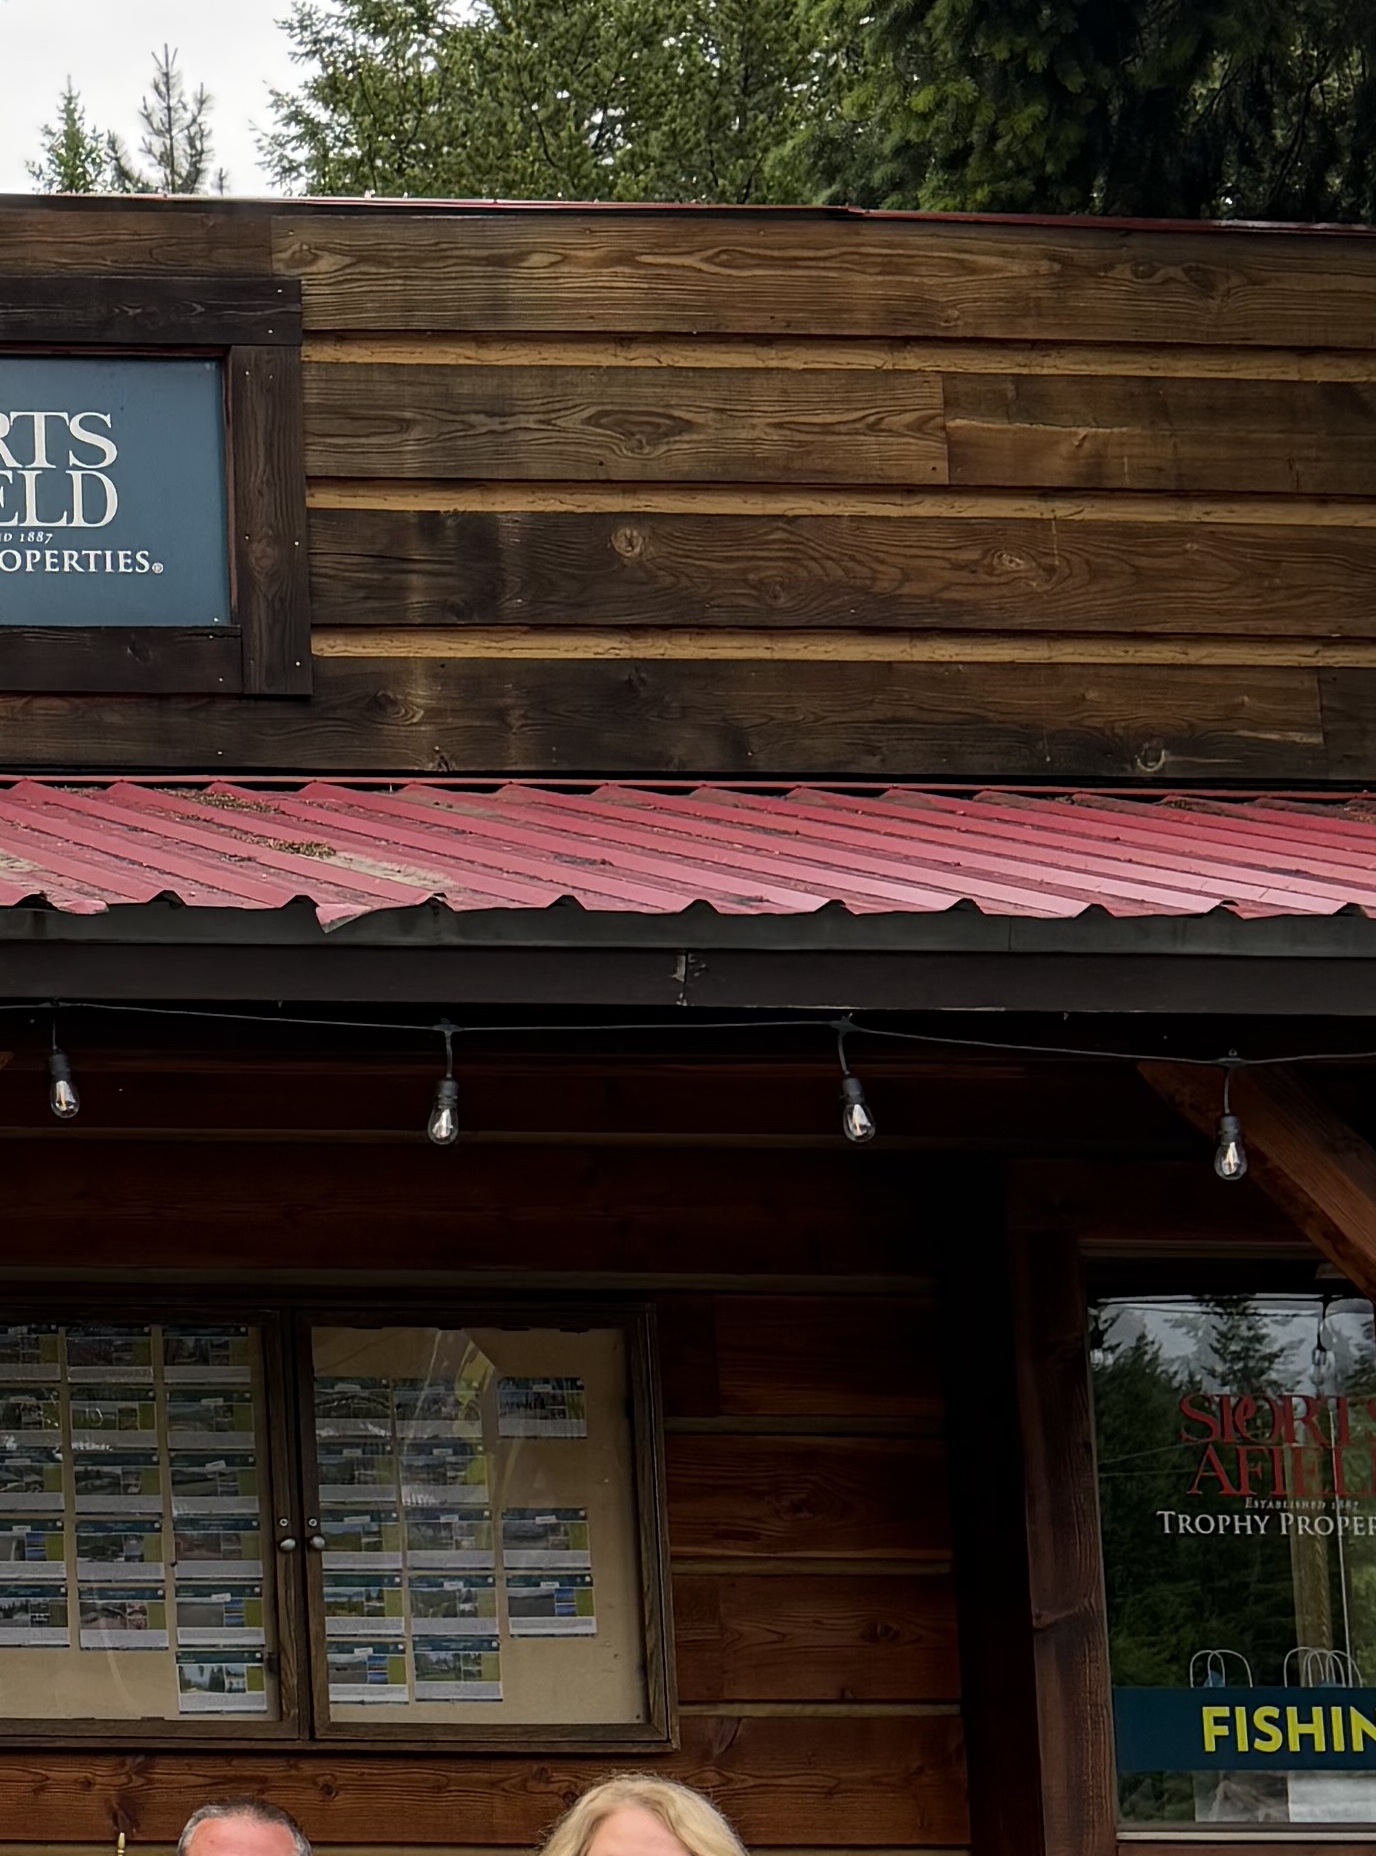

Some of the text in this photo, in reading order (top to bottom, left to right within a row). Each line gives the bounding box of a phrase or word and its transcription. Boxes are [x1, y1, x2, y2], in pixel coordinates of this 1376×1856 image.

[19, 530, 53, 544] 1887
[1178, 1393, 1376, 1447] SPORT
[1185, 1442, 1376, 1498] AFIEL
[1156, 1510, 1270, 1535] TROPHY
